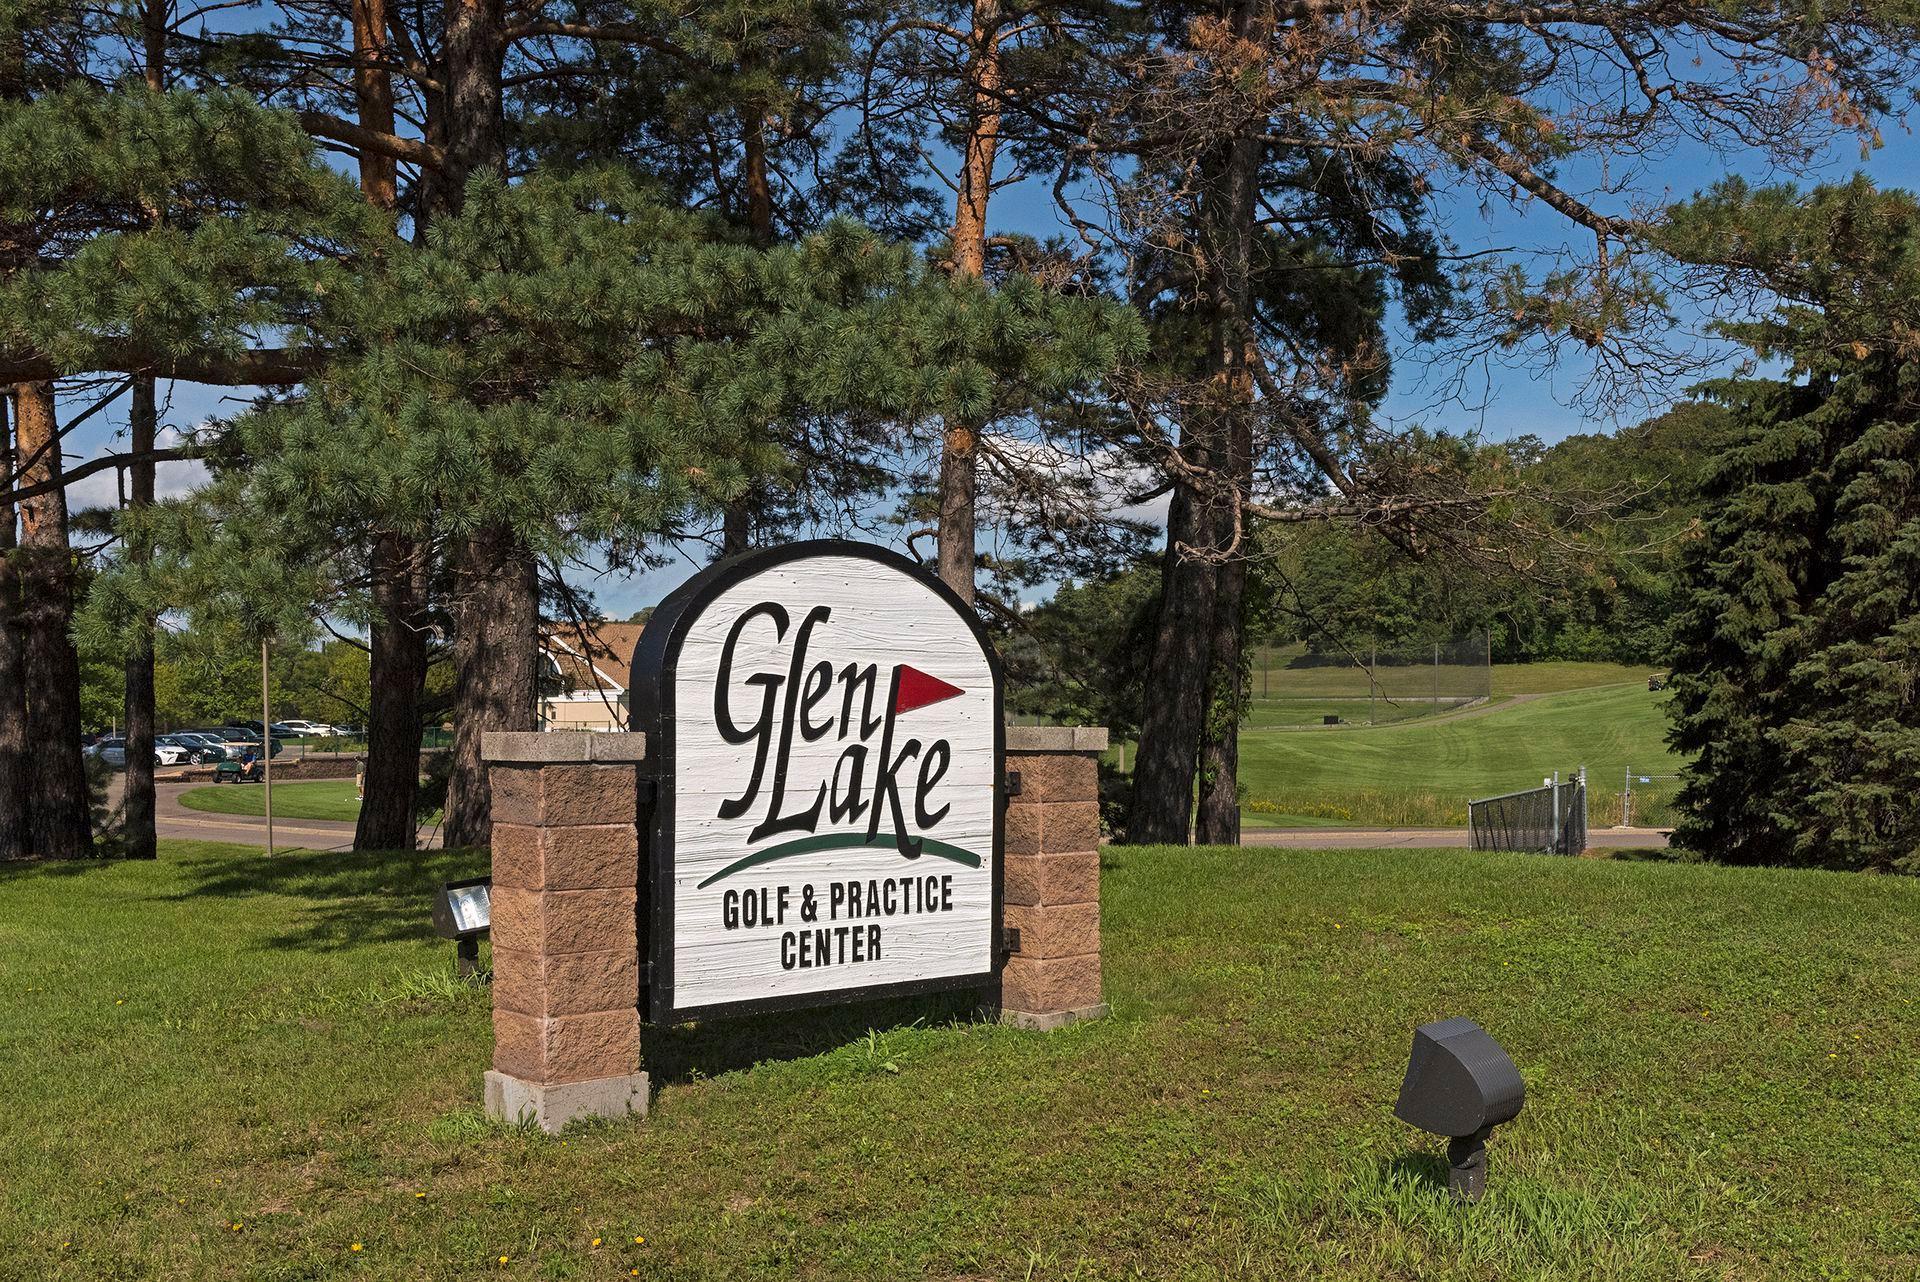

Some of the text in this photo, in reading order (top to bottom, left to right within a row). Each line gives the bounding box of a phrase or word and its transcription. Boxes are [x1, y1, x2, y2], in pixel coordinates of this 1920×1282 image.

[714, 601, 882, 819] Glen
[747, 664, 951, 860] Lake
[722, 874, 953, 929] GOLF & PRACTICE
[780, 923, 882, 970] CENTER
